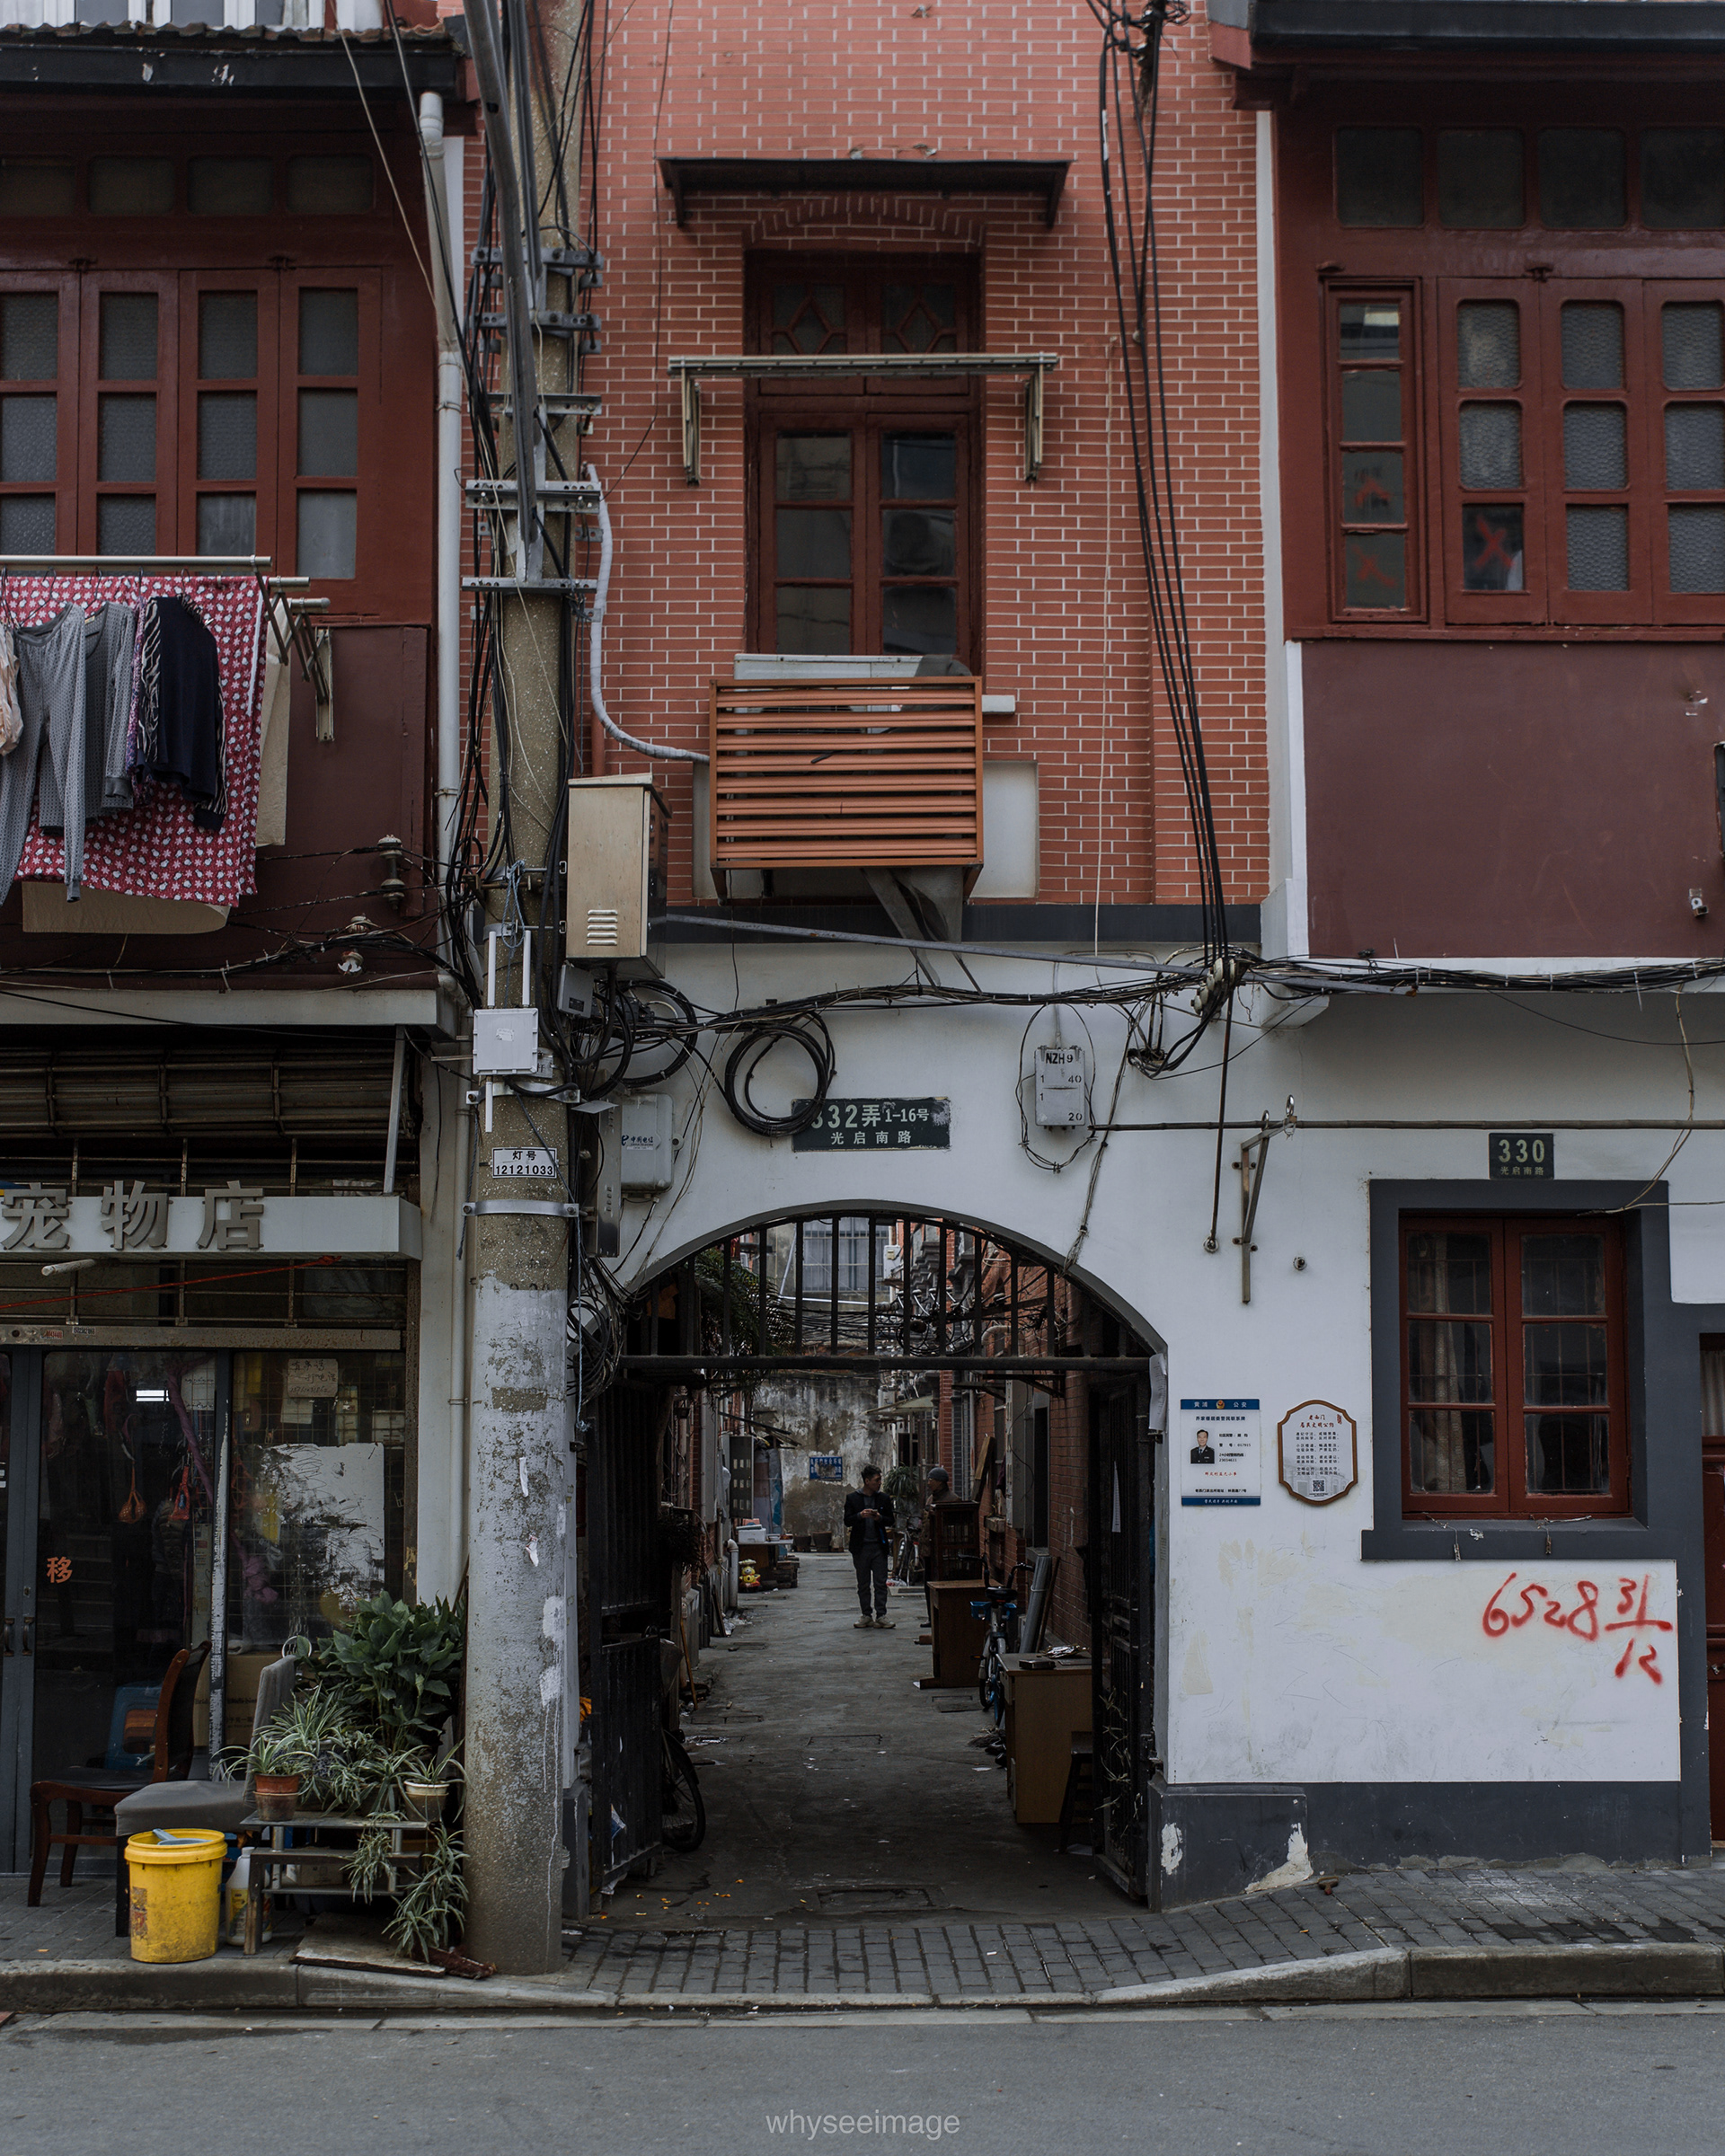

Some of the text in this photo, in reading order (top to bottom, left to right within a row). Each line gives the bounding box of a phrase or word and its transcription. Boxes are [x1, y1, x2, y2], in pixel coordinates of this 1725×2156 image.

[1067, 1074, 1082, 1083] 40
[1068, 1112, 1083, 1121] 20
[830, 1130, 912, 1145] 光启南路
[512, 1150, 537, 1162] 灯号
[1498, 1139, 1545, 1163] 330
[496, 1164, 553, 1176] 12121033
[1499, 1165, 1544, 1176] 光启南路
[0, 1180, 265, 1250] 宠物店
[46, 1555, 74, 1585] 移
[1482, 1572, 1599, 1641] 6528
